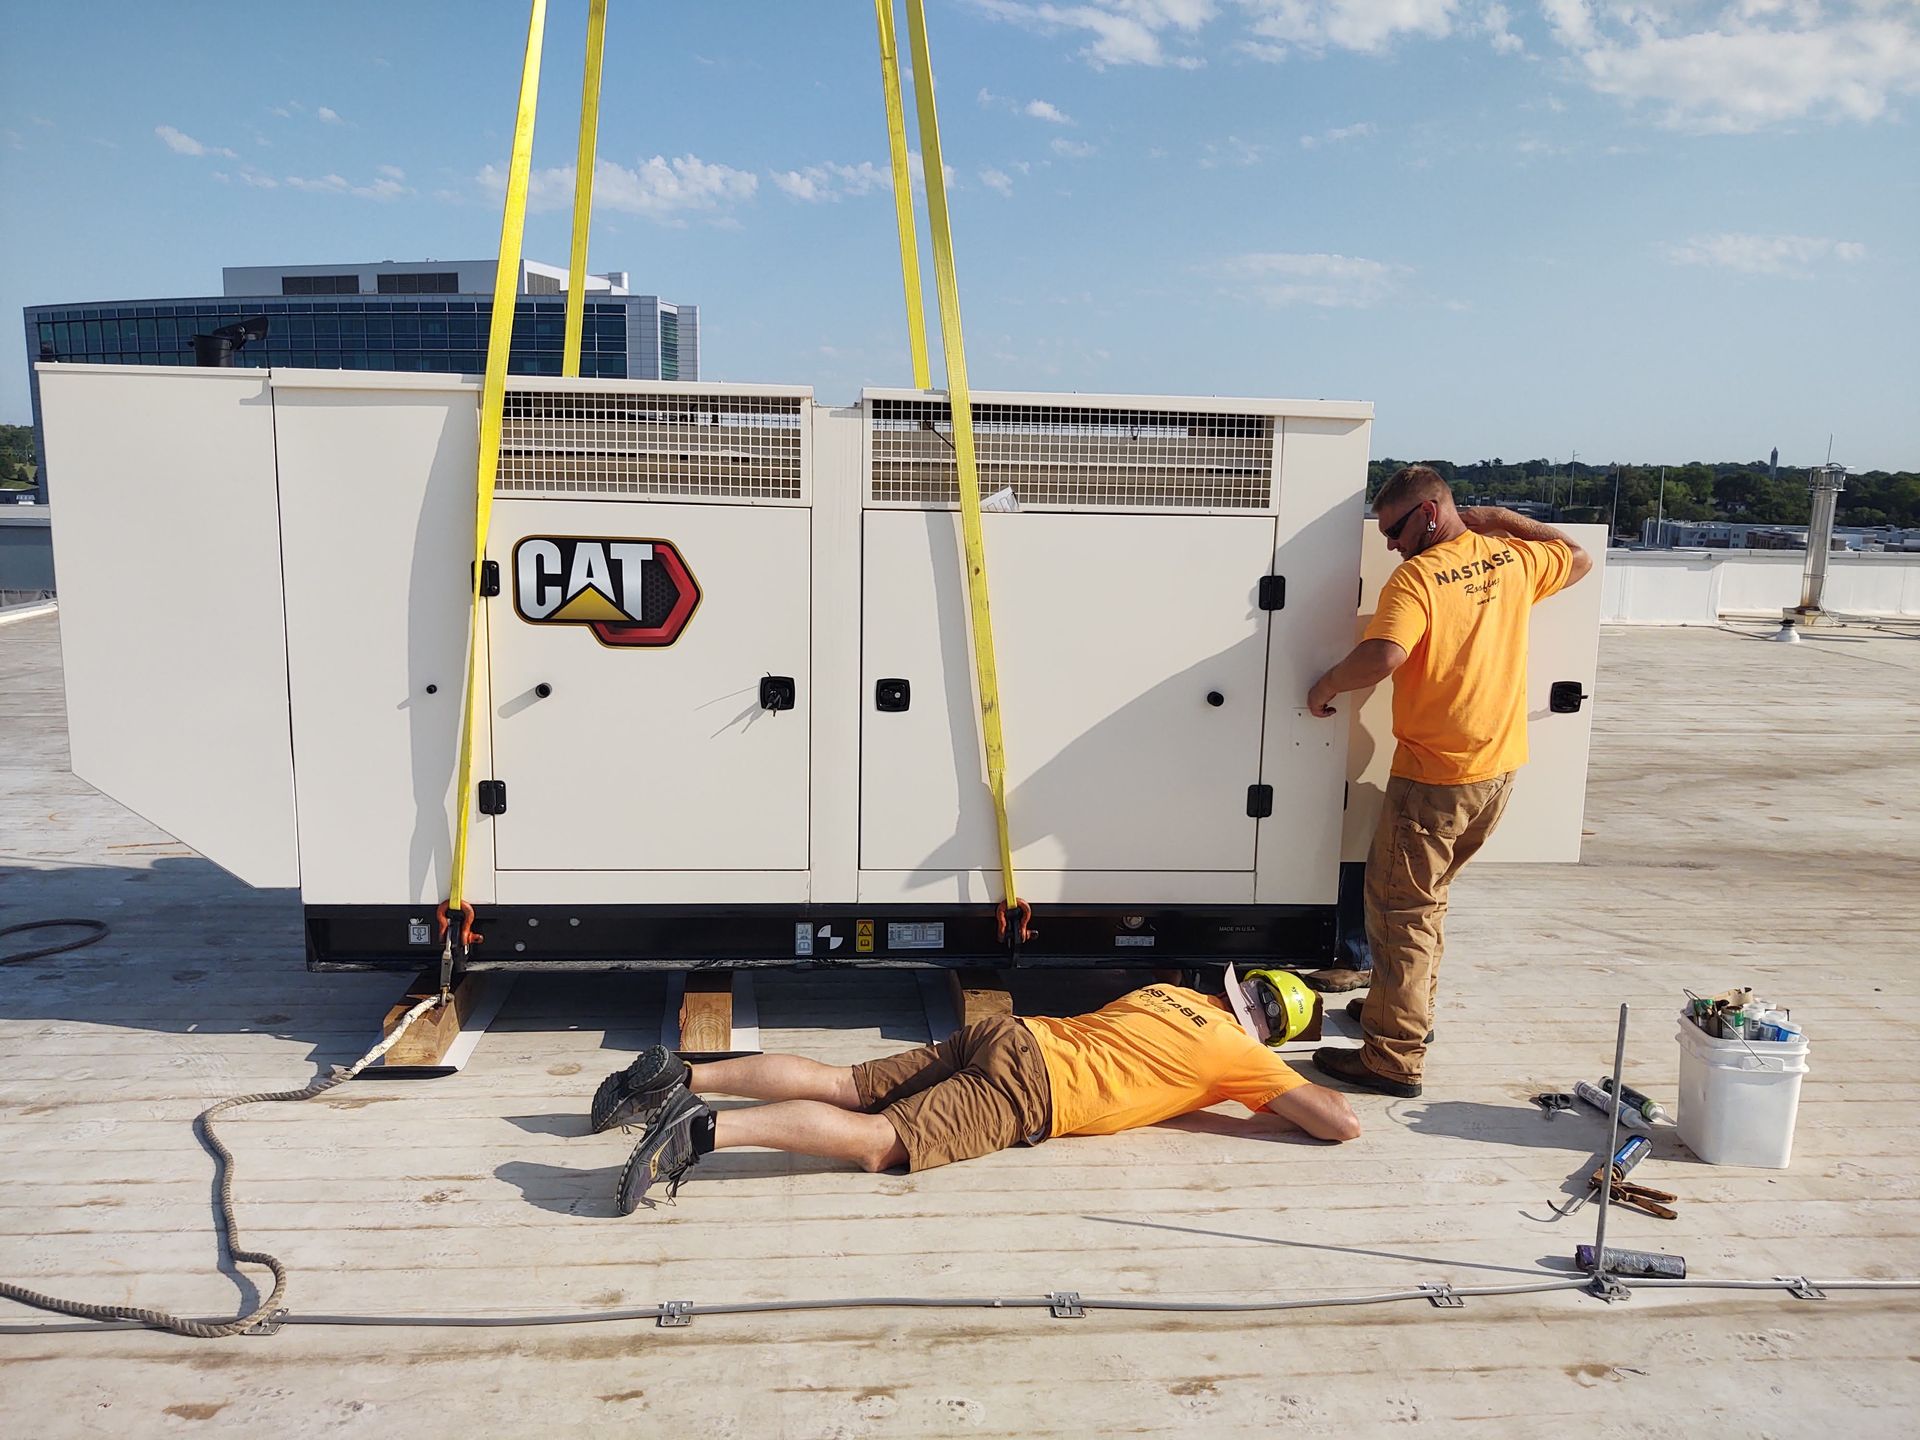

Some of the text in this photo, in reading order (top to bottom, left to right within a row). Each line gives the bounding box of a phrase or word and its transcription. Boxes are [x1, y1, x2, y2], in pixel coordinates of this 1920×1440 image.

[518, 539, 653, 621] CAT
[1433, 550, 1515, 586] NASTASE
[1141, 988, 1208, 1028] ASTASE
